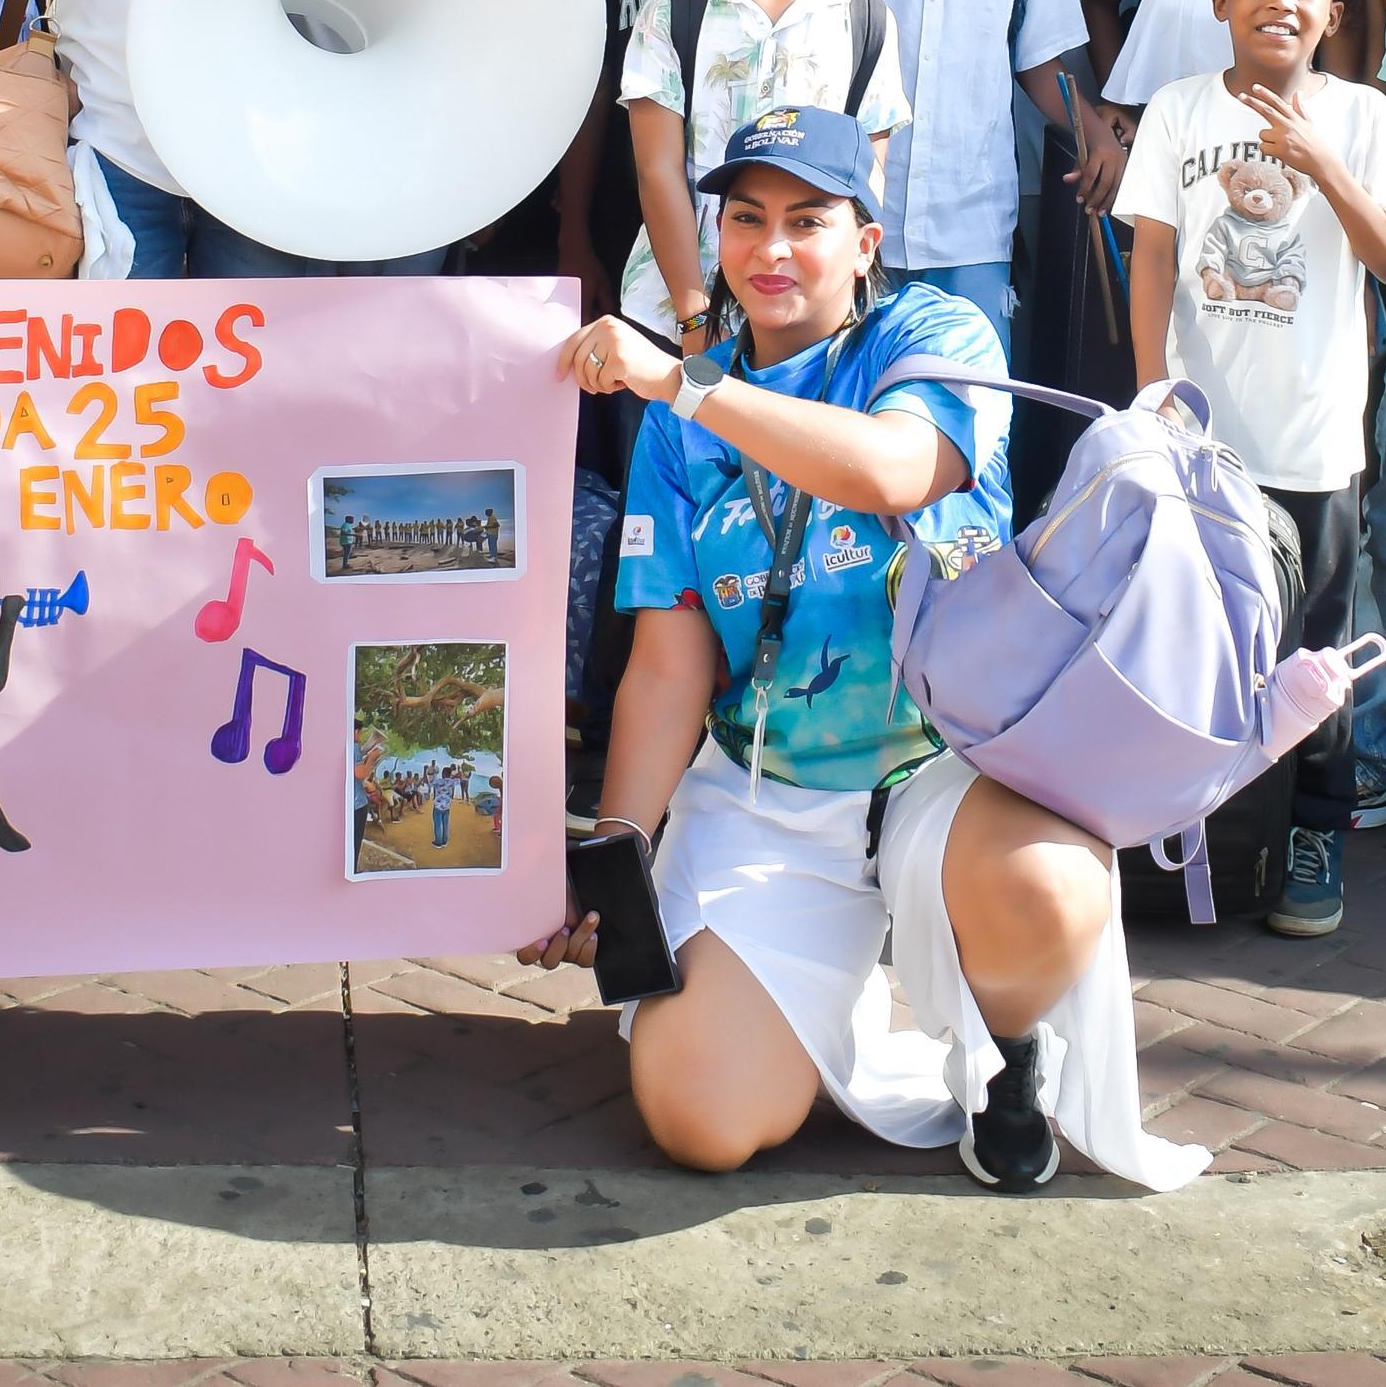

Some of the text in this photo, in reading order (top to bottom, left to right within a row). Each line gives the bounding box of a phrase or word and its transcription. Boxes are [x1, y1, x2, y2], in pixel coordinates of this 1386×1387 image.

[1202, 303, 1294, 324] SOFT BUT FIERCE
[66, 381, 186, 460] 25
[20, 461, 253, 535] ENERO
[825, 547, 869, 566] icultur
